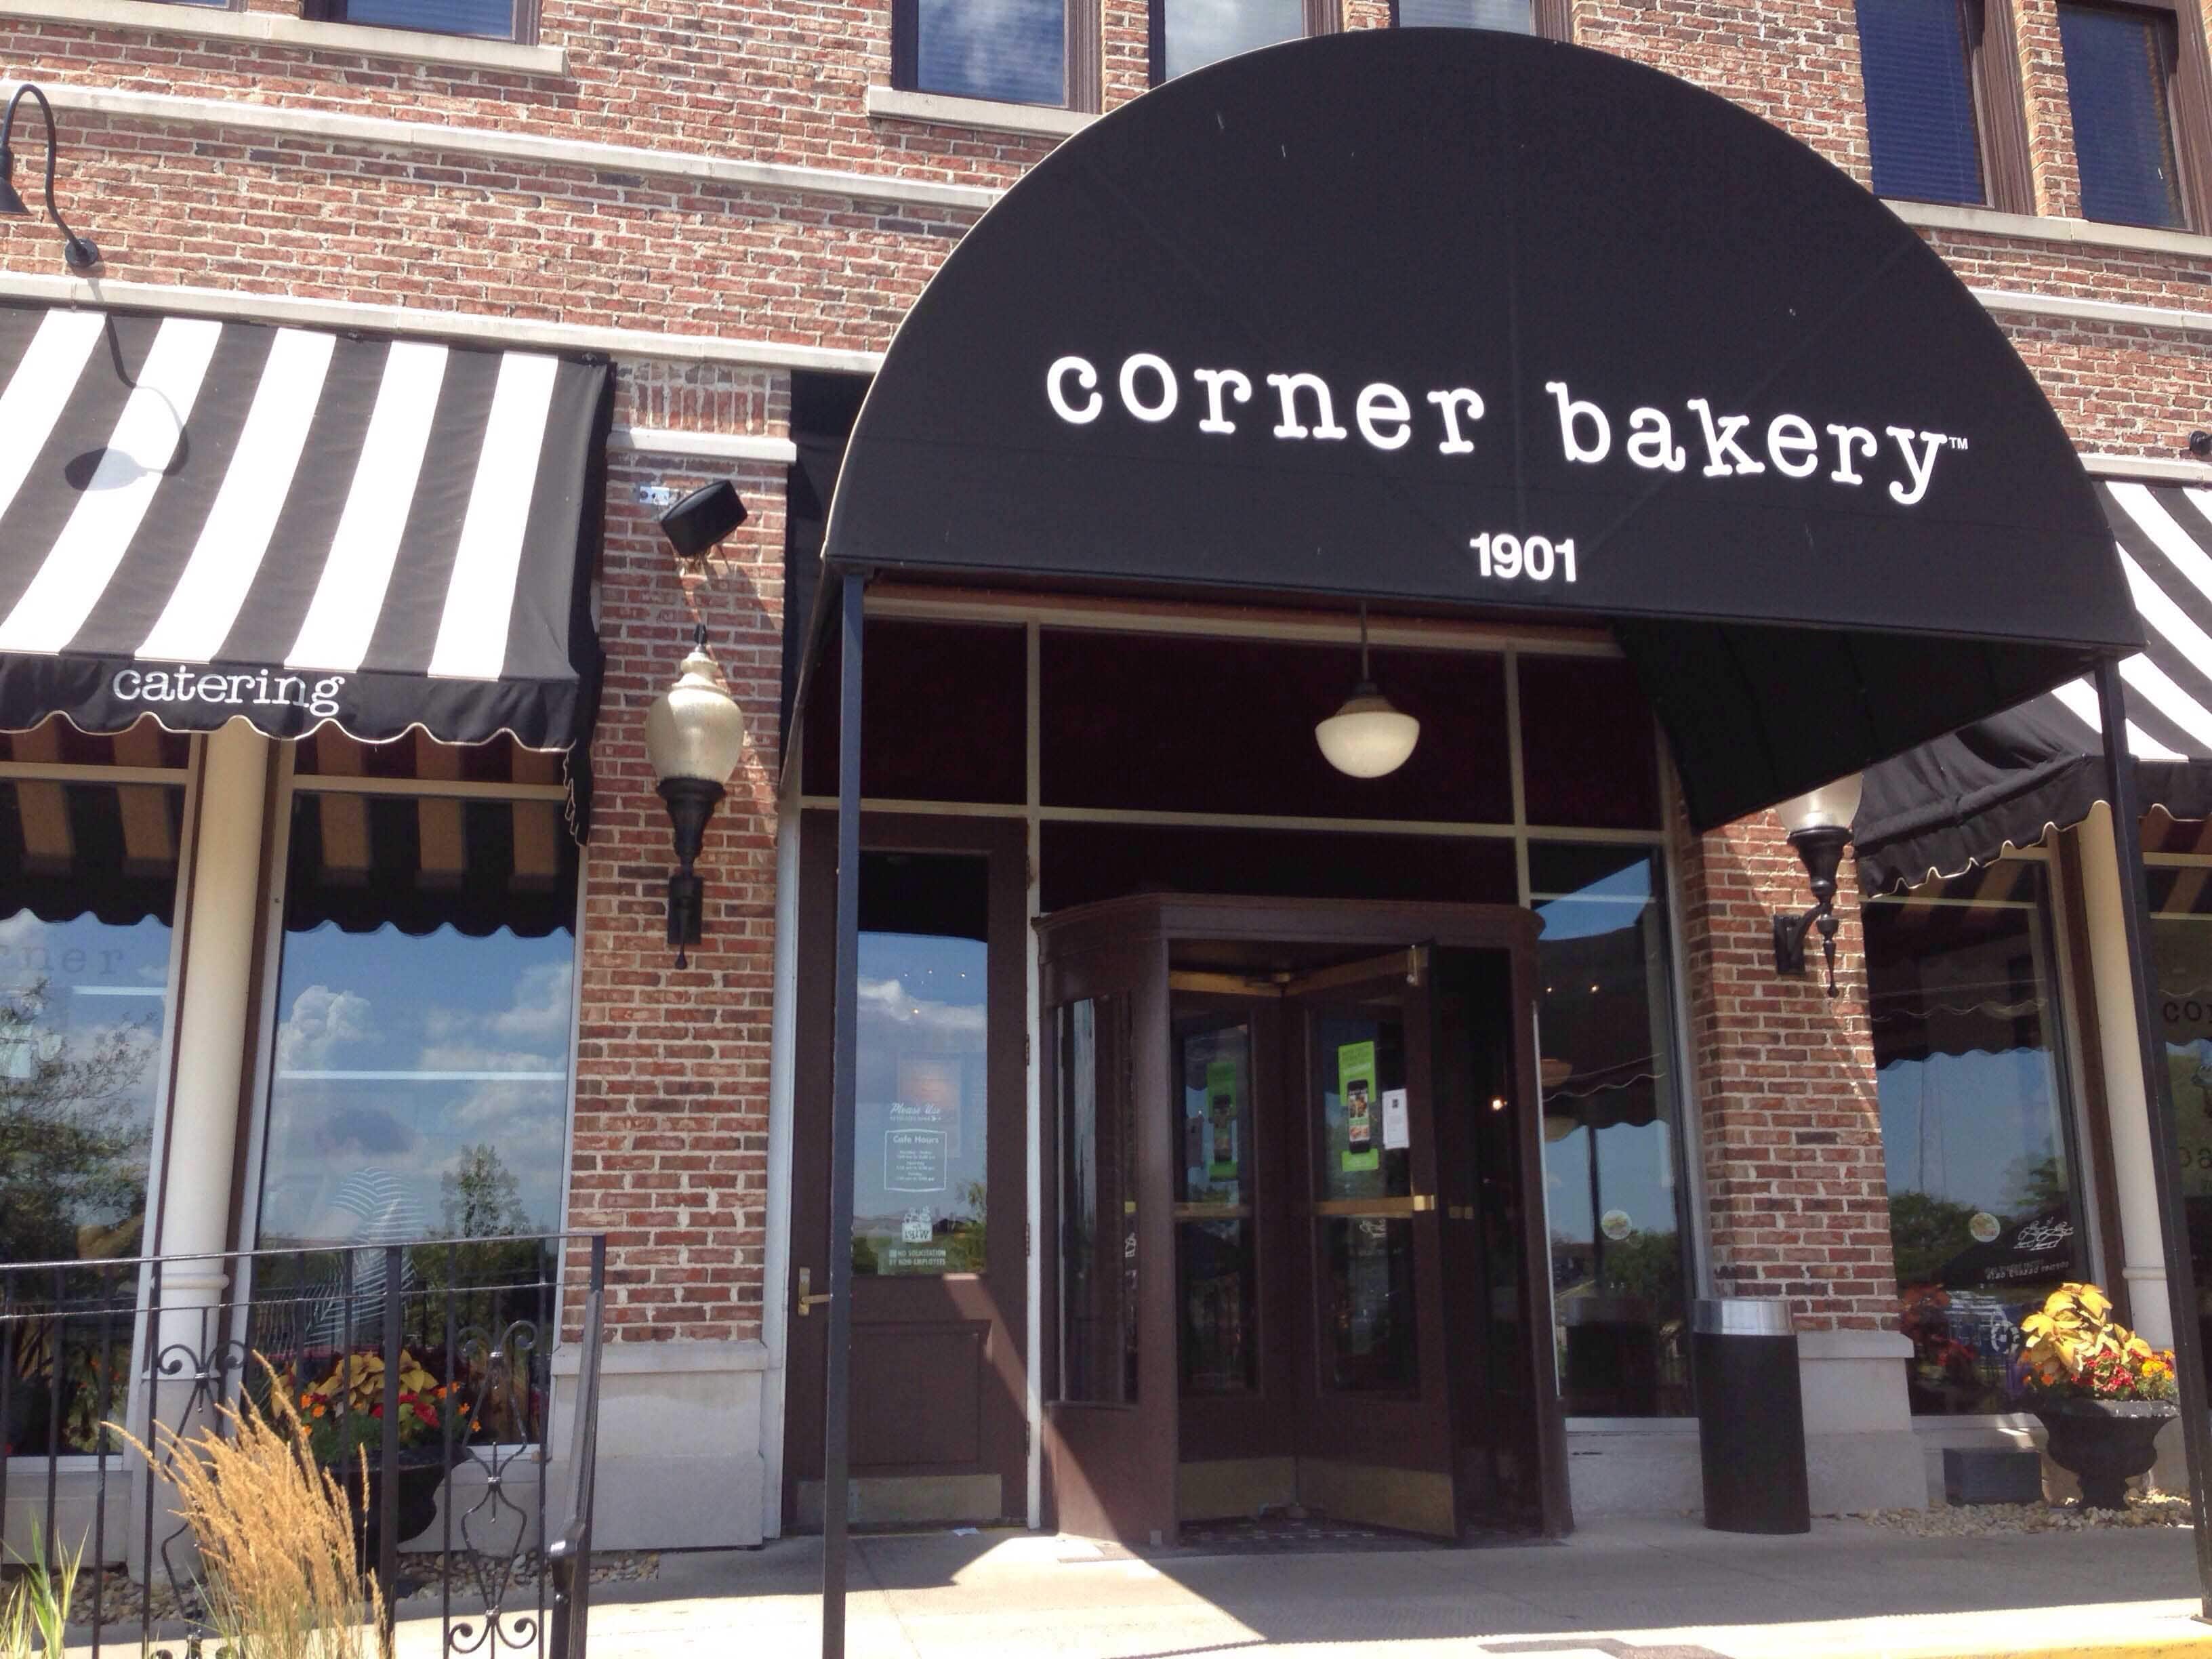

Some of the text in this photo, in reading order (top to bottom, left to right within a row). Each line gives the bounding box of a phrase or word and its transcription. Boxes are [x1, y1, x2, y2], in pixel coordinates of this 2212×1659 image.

[1047, 353, 1484, 453] corner
[1546, 382, 1947, 504] bakery
[1470, 533, 1576, 582] 1901
[113, 665, 345, 717] catering
[893, 1135, 939, 1144] Cafe Hours
